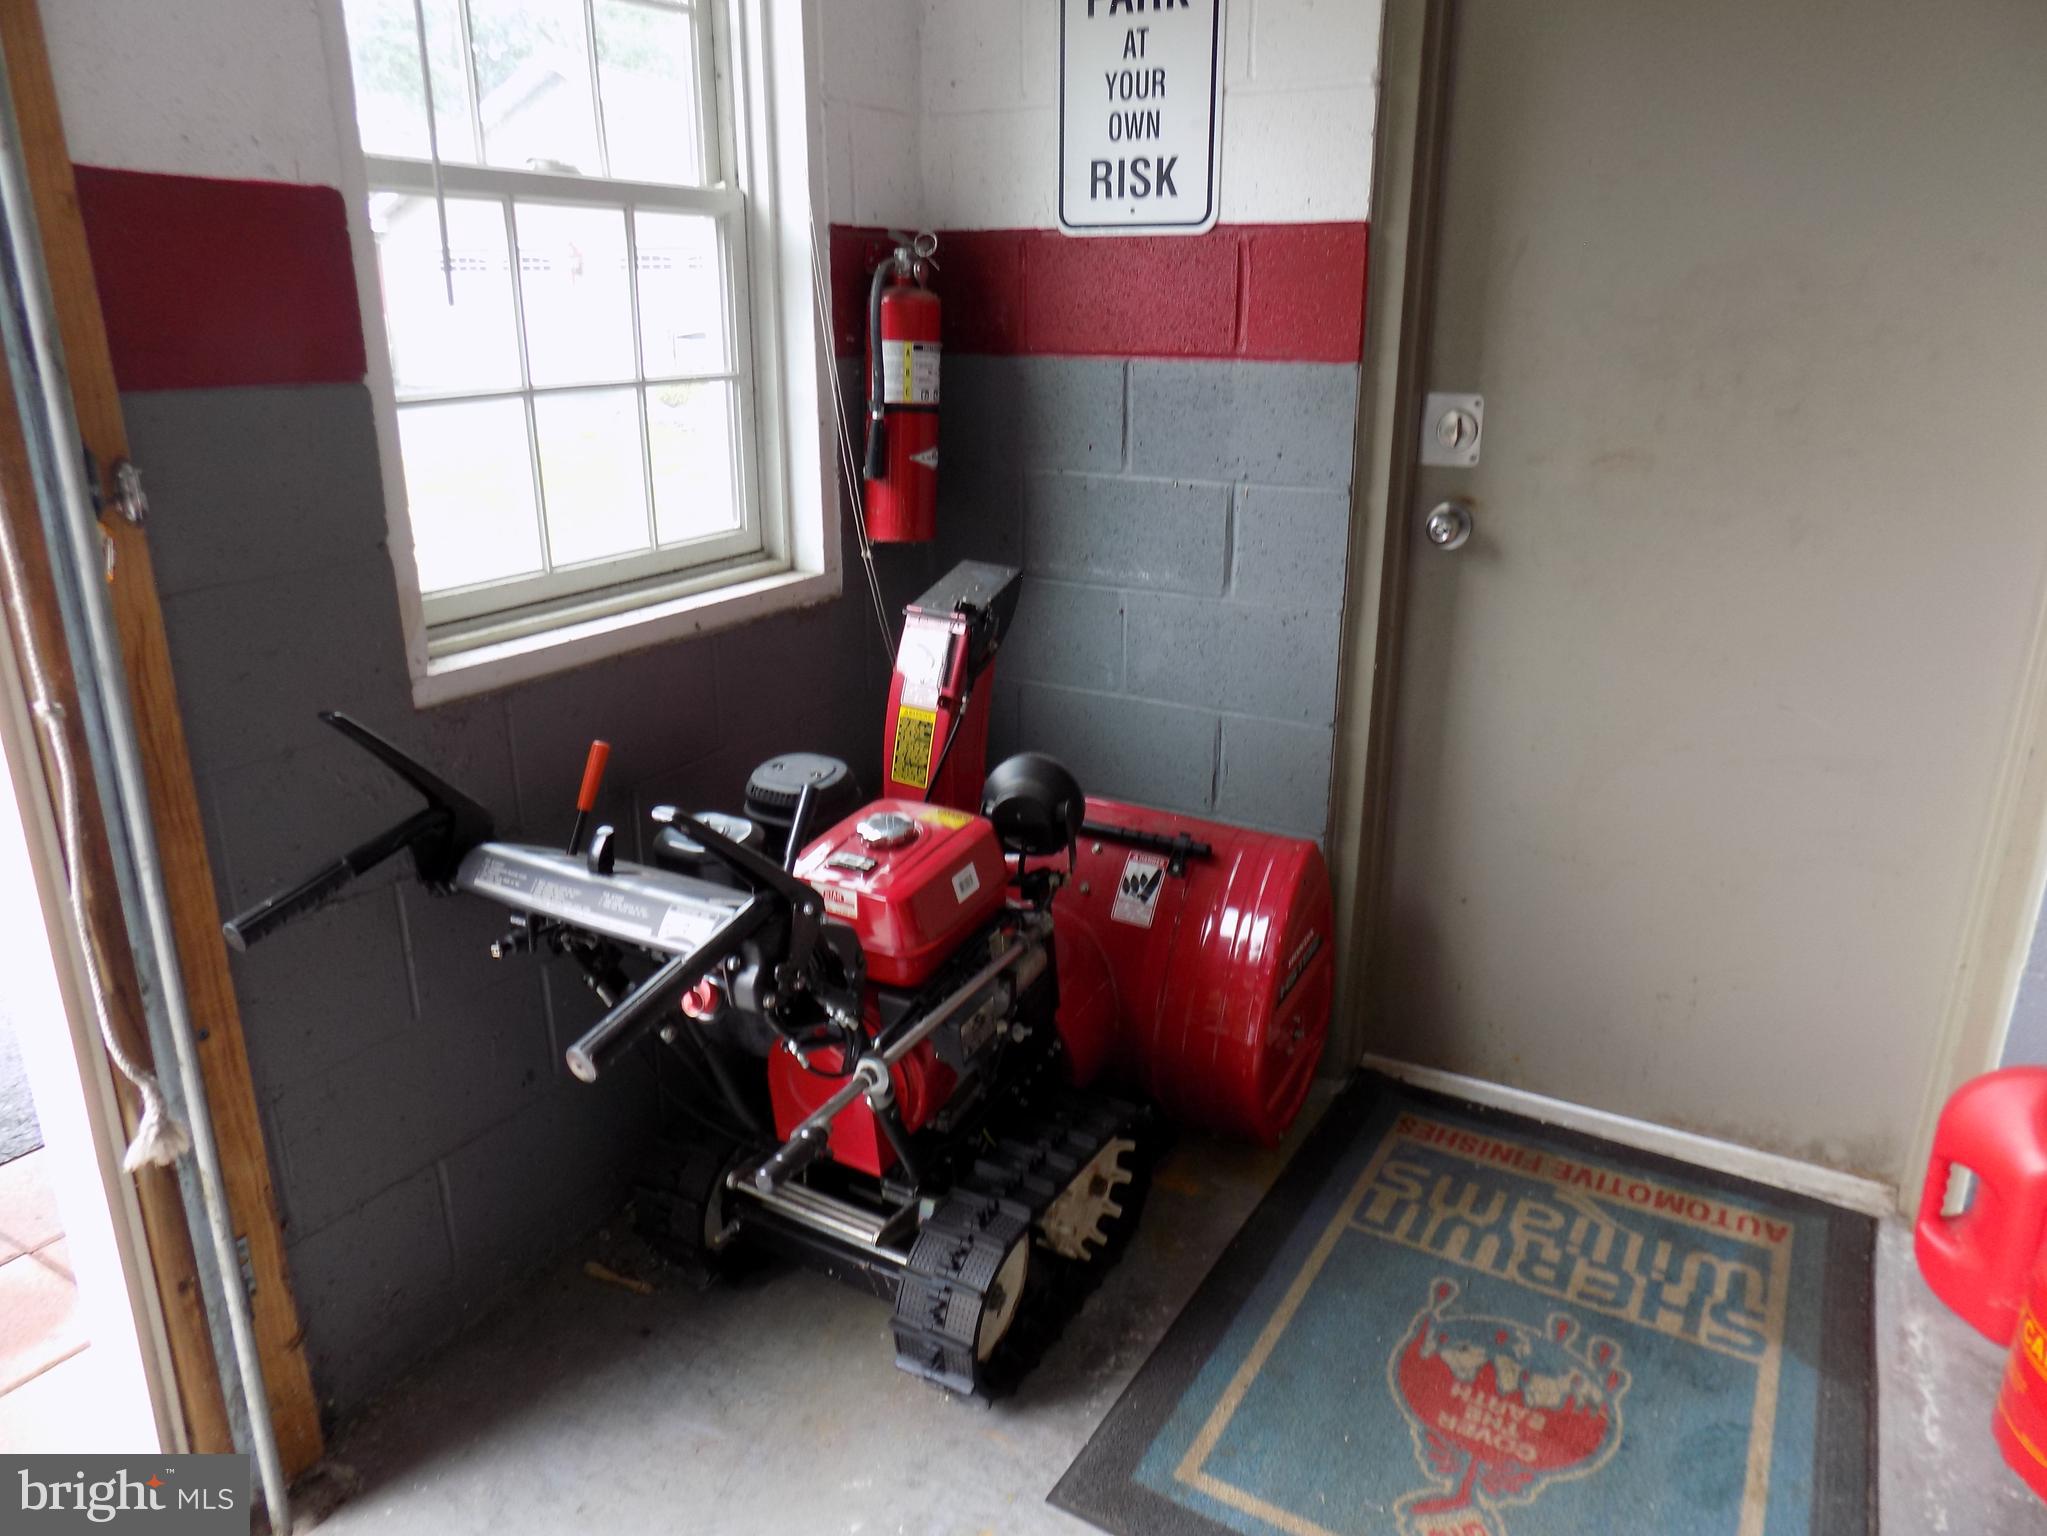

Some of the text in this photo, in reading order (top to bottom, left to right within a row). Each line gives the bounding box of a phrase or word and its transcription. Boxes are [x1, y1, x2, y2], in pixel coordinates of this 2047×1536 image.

[1122, 27, 1149, 60] AT
[1105, 67, 1166, 102] YOUR
[1108, 109, 1161, 142] OWN
[1089, 154, 1179, 201] RISK
[1396, 1115, 1790, 1244] AUTOMOTIVE FINISHES
